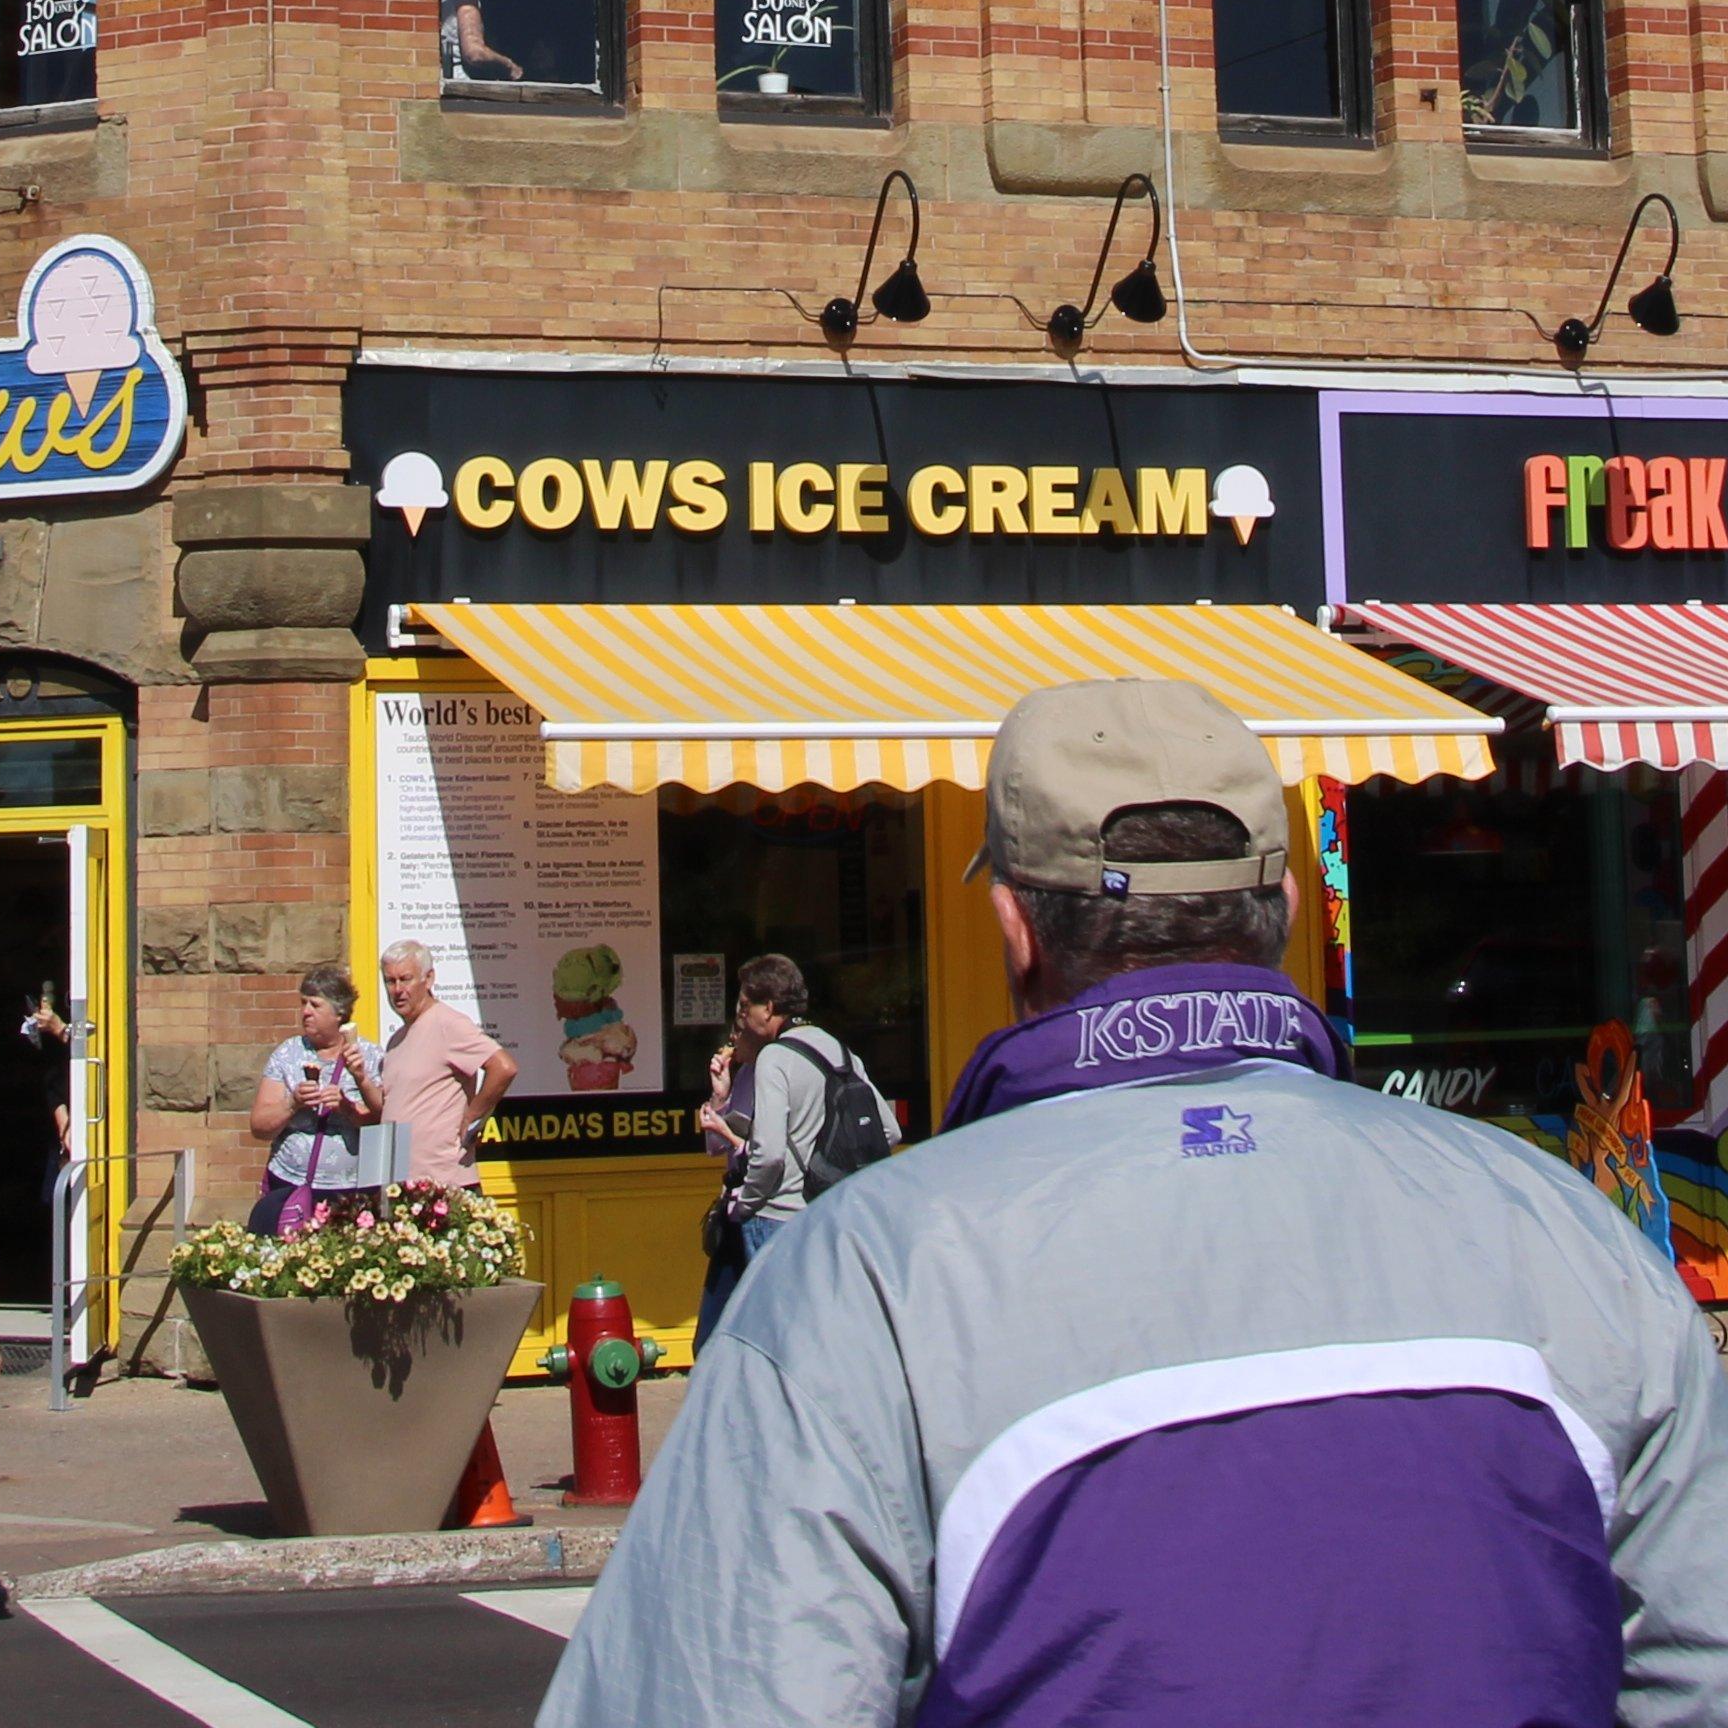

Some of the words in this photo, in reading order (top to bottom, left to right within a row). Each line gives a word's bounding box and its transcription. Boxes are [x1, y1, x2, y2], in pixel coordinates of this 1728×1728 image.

[17, 13, 97, 57] SALON
[741, 12, 832, 44] SALON
[452, 456, 729, 533] COWS
[748, 461, 890, 534] ICE
[907, 463, 1209, 537] CREAM
[383, 699, 478, 726] World's
[485, 699, 532, 725] best
[1381, 1066, 1497, 1107] CANDY
[477, 1111, 605, 1144] ANADA'S
[613, 1109, 686, 1137] BEST
[1181, 1141, 1258, 1159] STARTER
